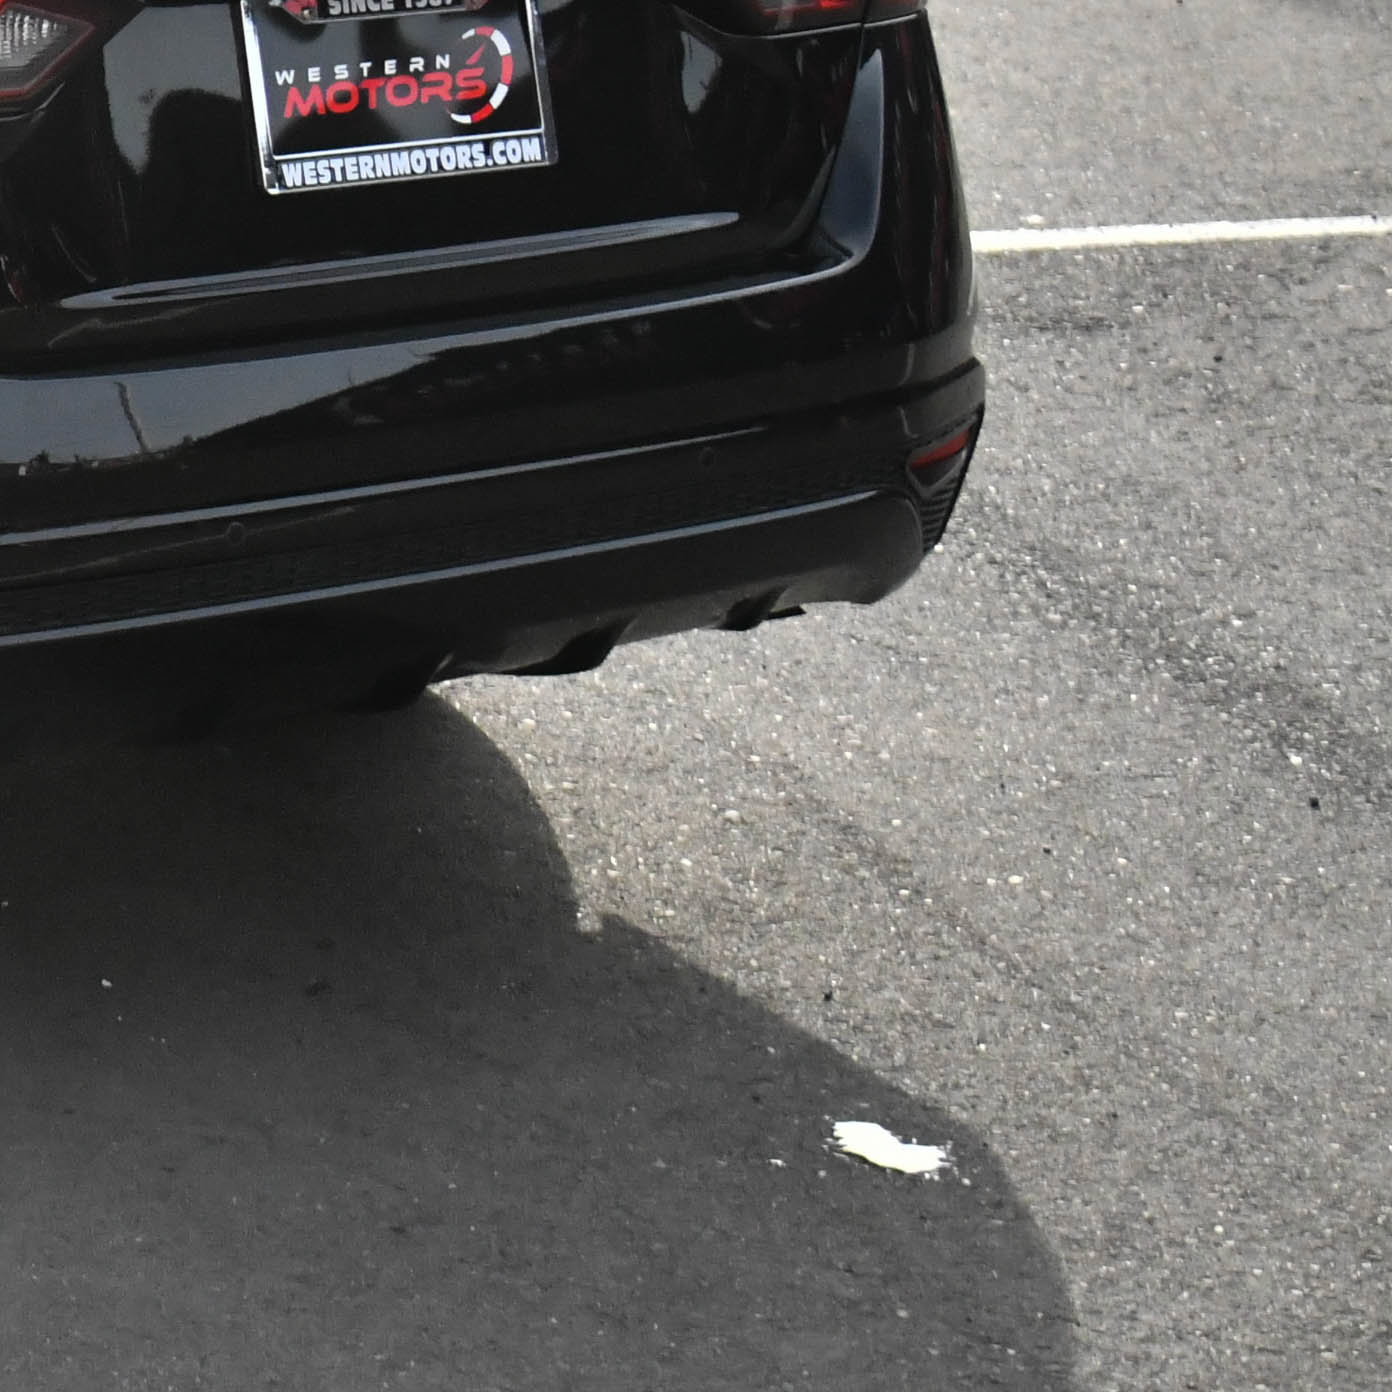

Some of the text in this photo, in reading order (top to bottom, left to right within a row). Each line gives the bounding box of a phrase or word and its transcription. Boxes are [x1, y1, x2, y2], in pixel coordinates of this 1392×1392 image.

[275, 54, 451, 85] WESTERN
[284, 67, 488, 119] MOTORS
[281, 136, 543, 189] WESTERNMOTORS.COM
